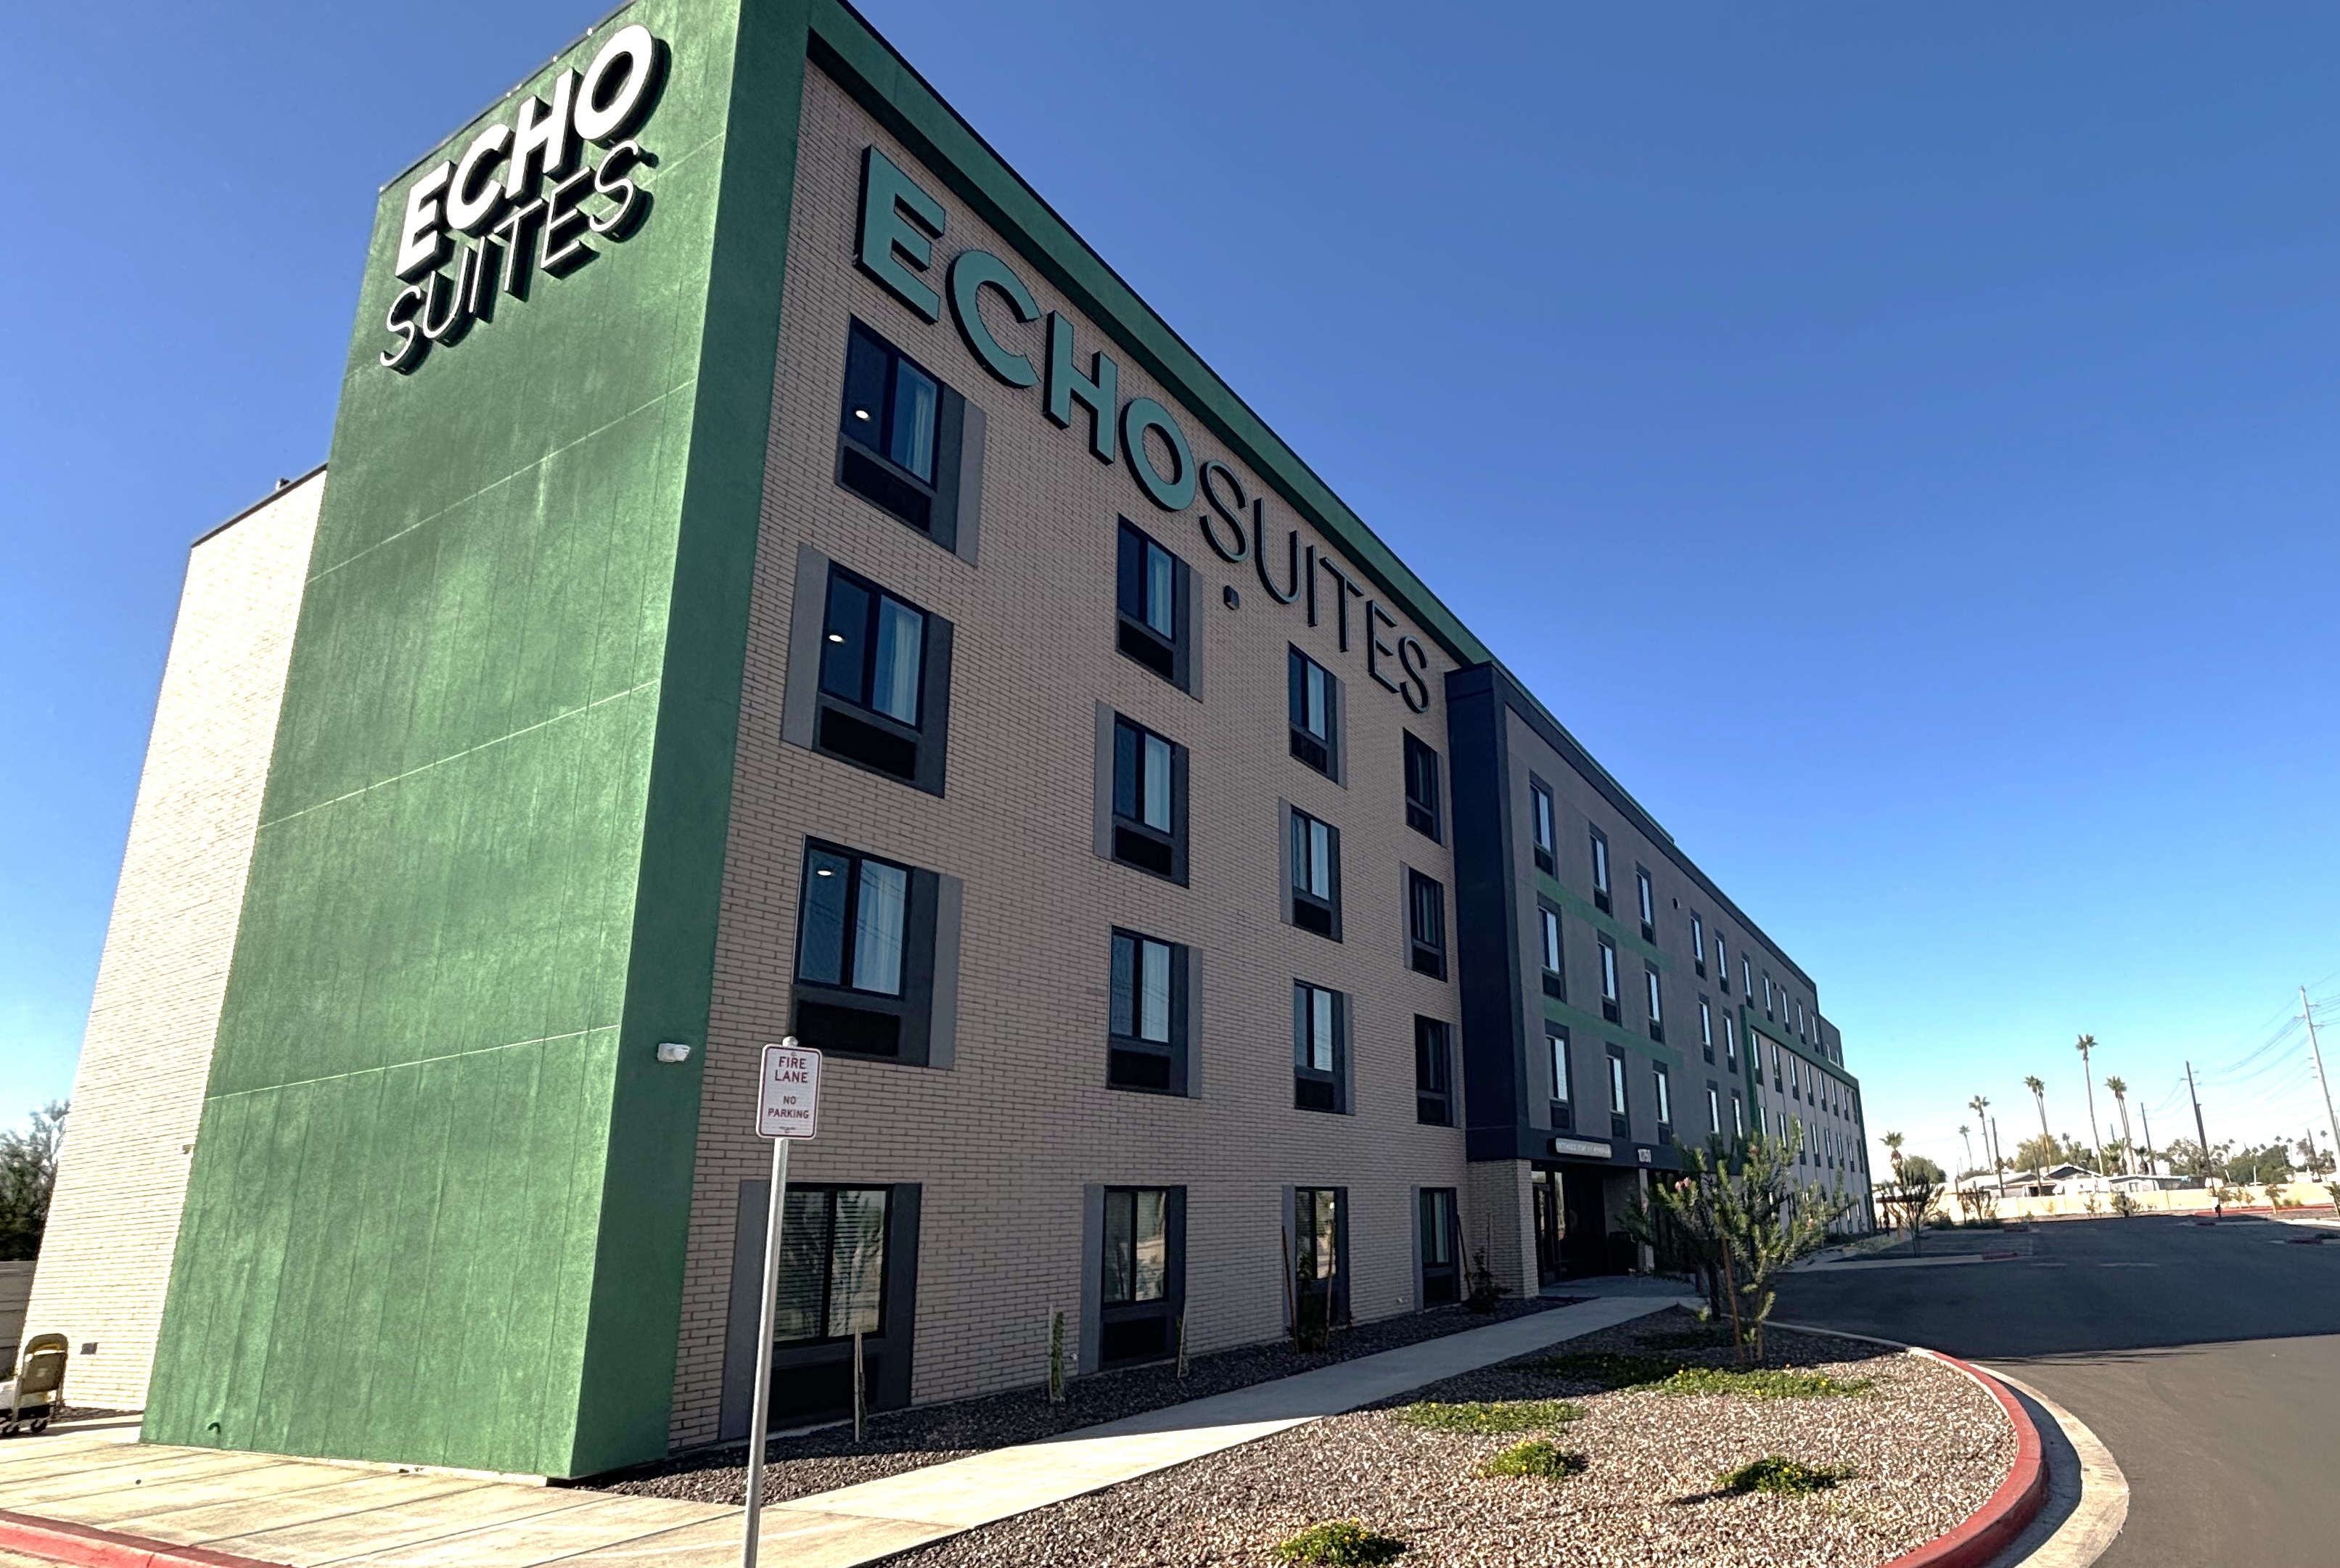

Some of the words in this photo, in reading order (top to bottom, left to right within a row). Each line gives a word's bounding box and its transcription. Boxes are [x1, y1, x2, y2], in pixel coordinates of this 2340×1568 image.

[395, 24, 655, 278] ECHO
[379, 139, 640, 367] SUITES
[854, 145, 1197, 512] ECHO
[1199, 459, 1431, 714] SUITES
[779, 1056, 807, 1070] FIRE
[774, 1070, 809, 1083] LANE
[783, 1096, 797, 1105] NO
[768, 1107, 809, 1119] PARKING
